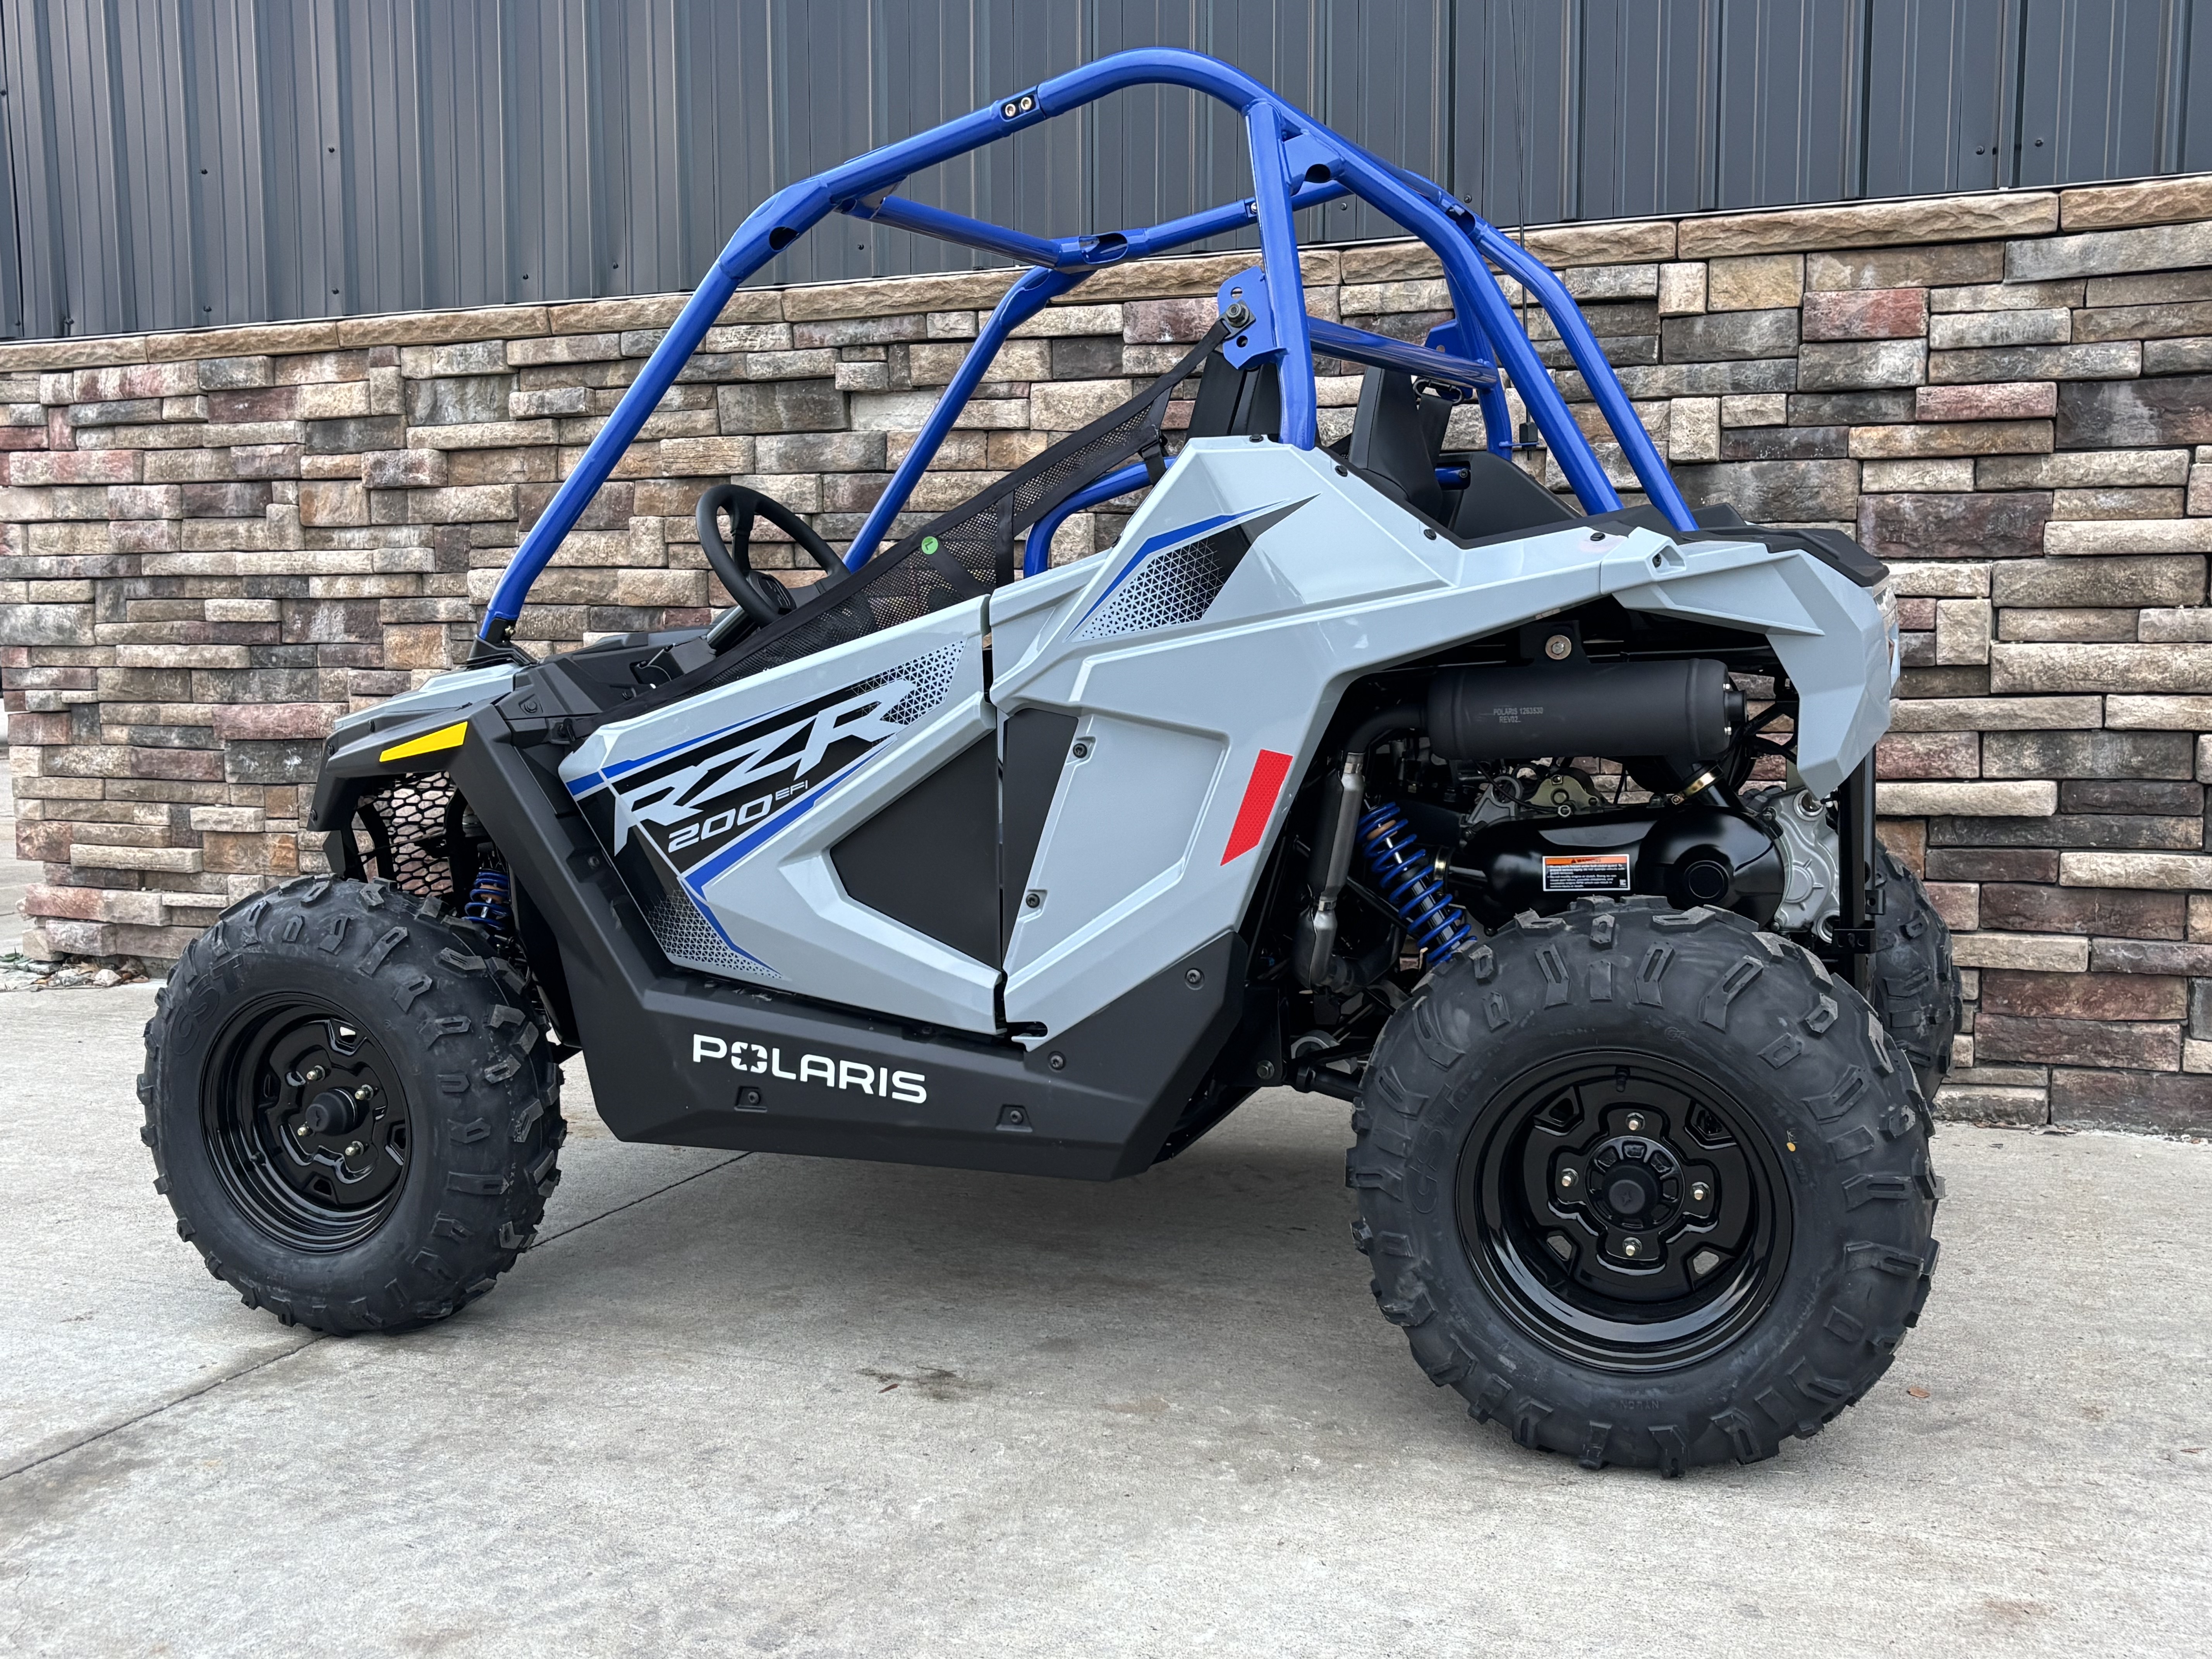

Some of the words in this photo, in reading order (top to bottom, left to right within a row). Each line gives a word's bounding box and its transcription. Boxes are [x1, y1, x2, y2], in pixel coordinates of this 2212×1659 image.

[925, 541, 933, 551] L
[614, 678, 915, 856] RZR
[668, 793, 773, 853] 200
[775, 780, 808, 801] EFI
[170, 953, 244, 1055] CST
[693, 1034, 927, 1104] POLARIS
[1406, 1083, 1461, 1214] CST
